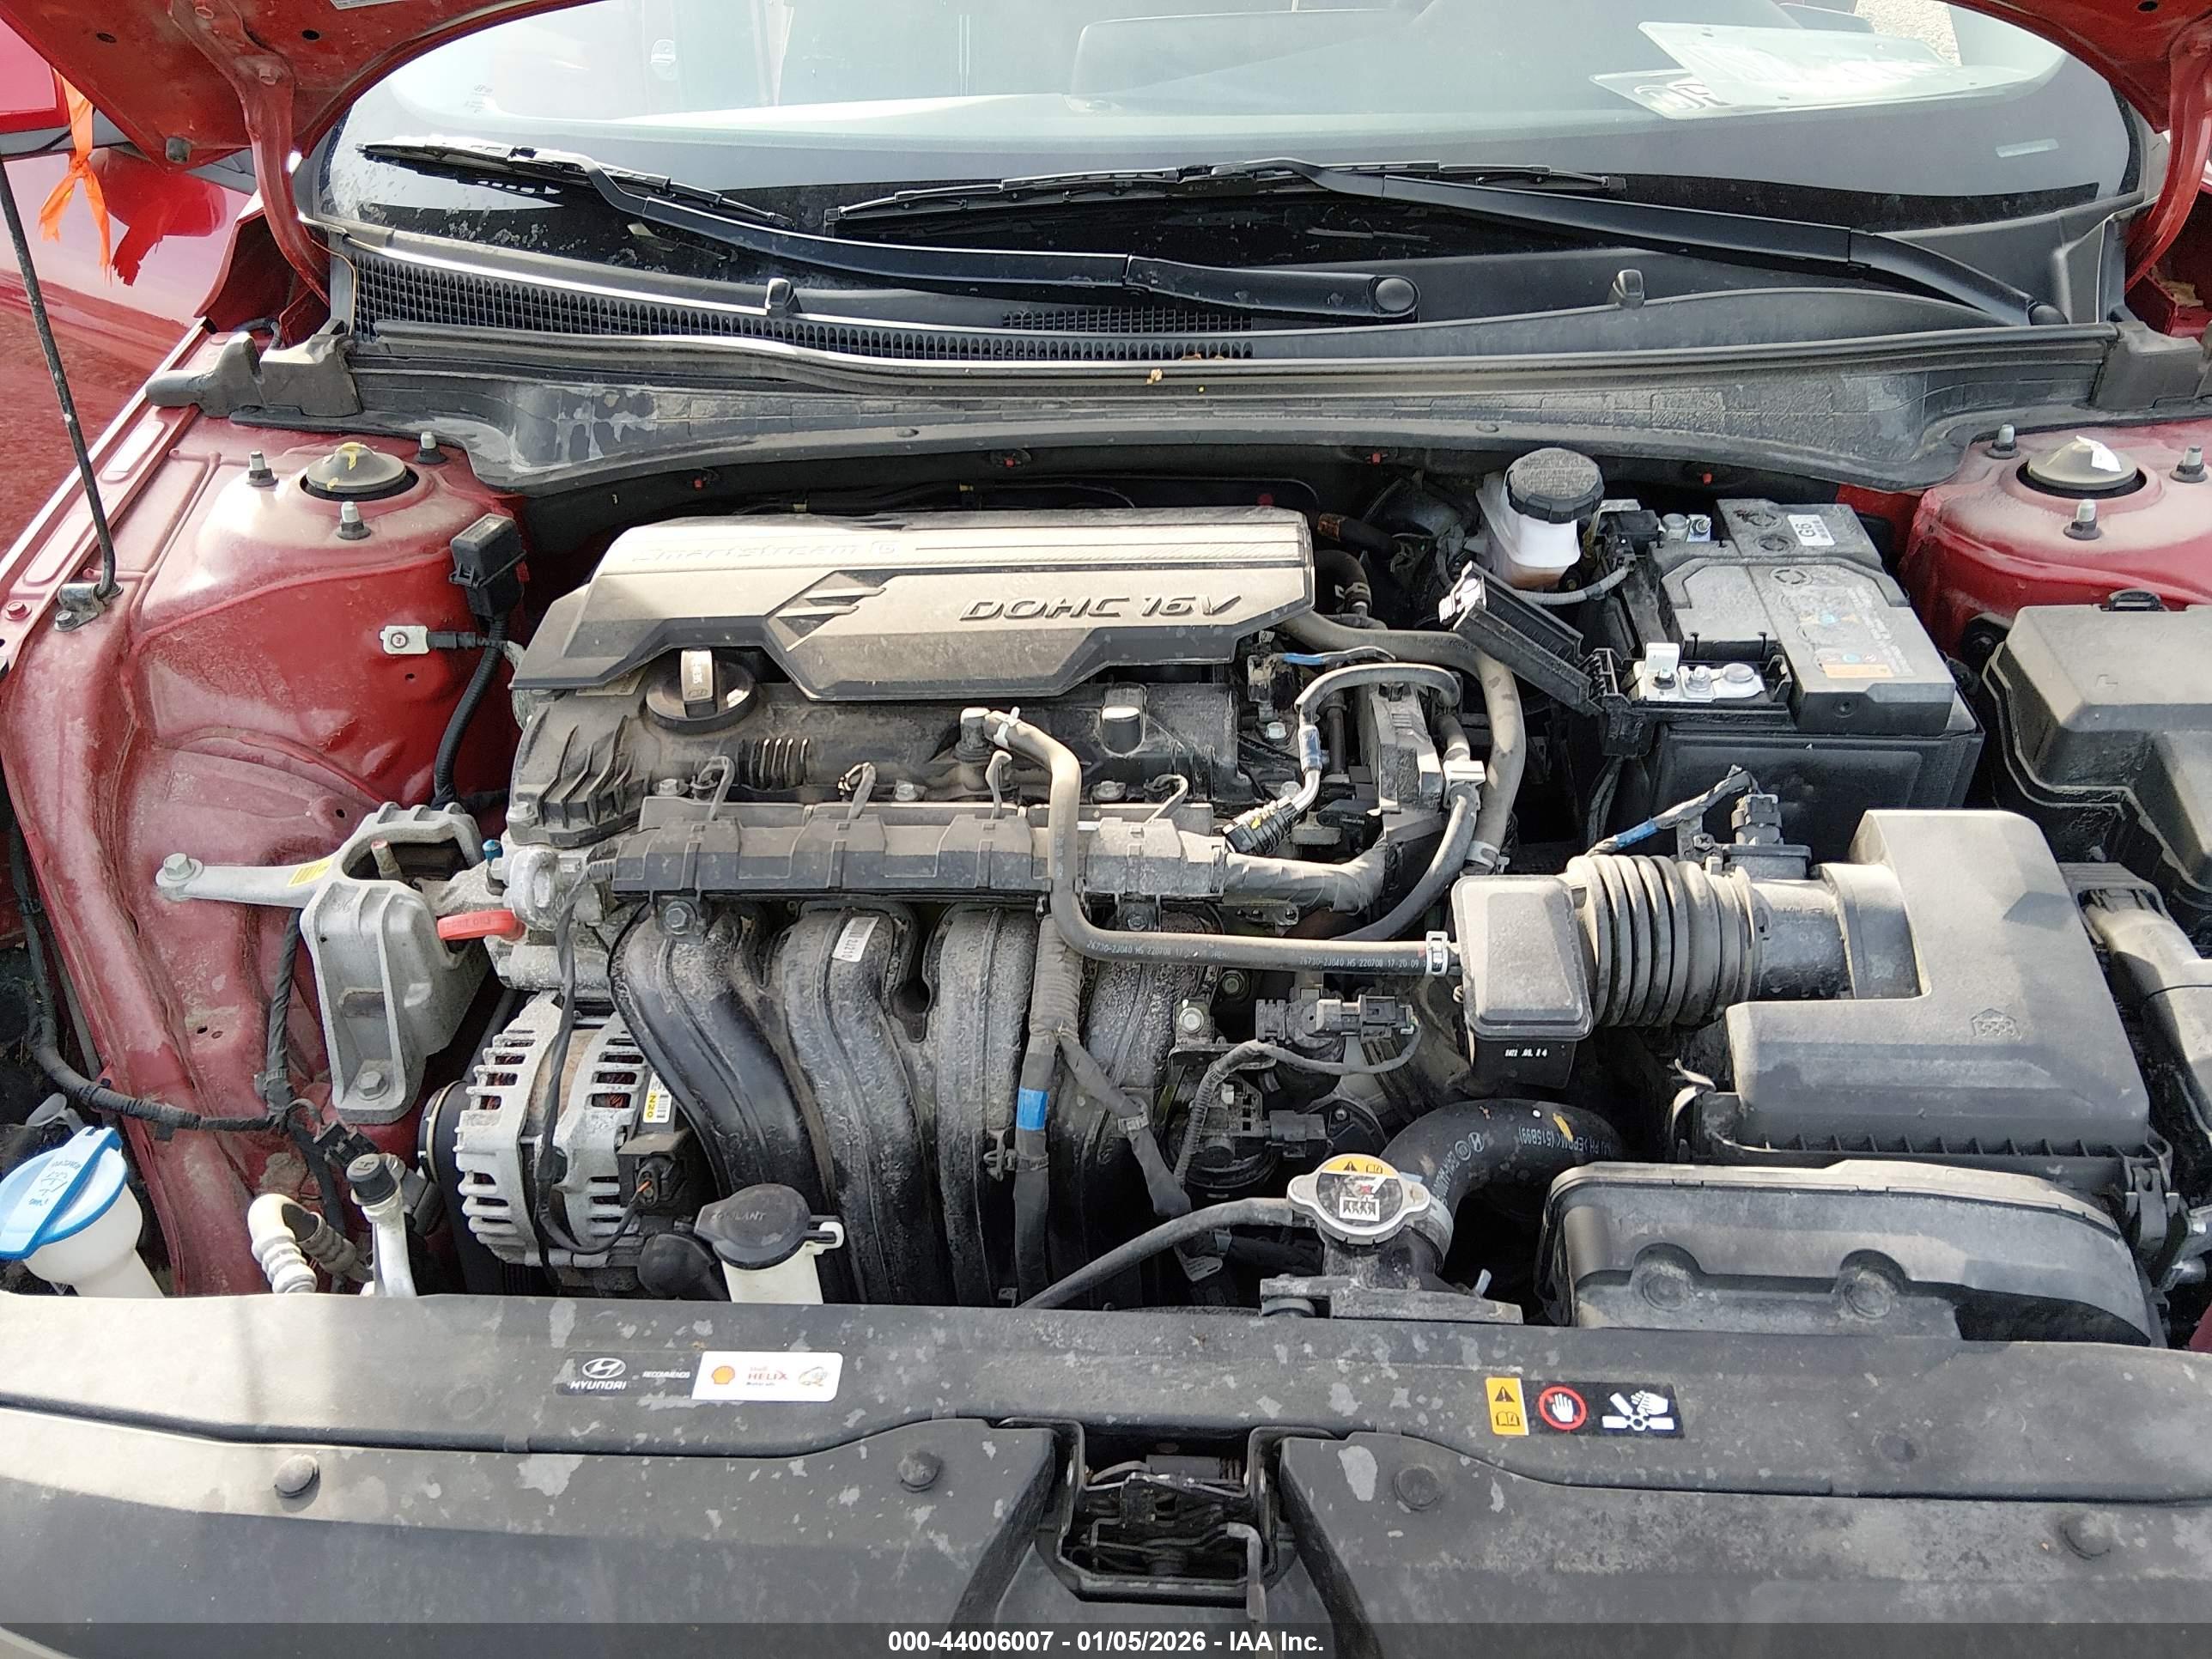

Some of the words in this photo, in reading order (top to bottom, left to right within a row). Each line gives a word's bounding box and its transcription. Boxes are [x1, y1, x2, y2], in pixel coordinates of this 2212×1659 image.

[959, 597, 1130, 621] DOHC
[1141, 594, 1242, 617] 16V
[647, 1095, 657, 1118] N20
[569, 1380, 628, 1390] HYUNDAI
[747, 1370, 789, 1381] HELIX
